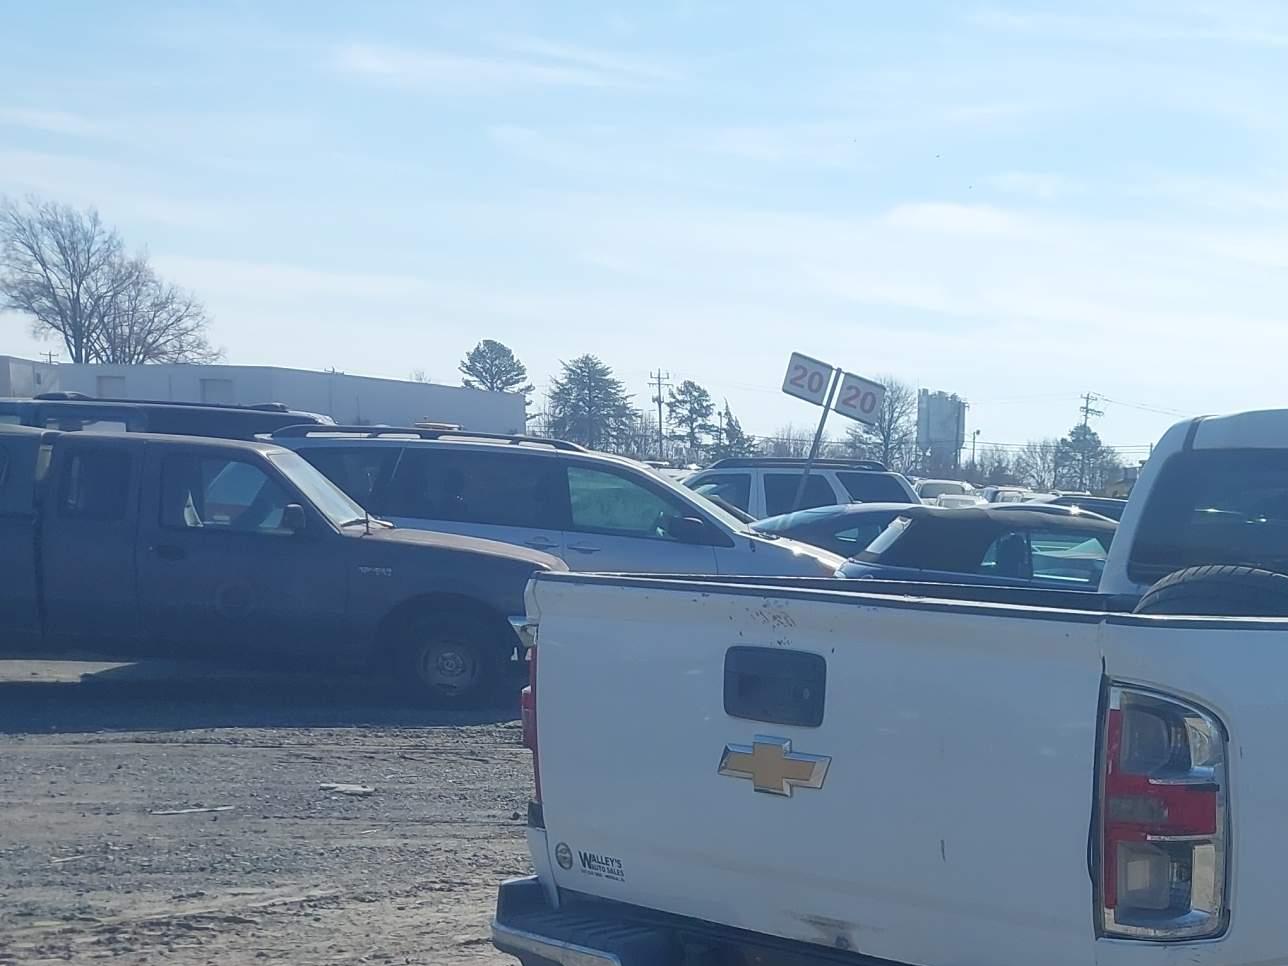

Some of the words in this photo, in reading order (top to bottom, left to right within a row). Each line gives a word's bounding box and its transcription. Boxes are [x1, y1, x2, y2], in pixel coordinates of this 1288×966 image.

[789, 365, 824, 393] 20
[842, 385, 877, 414] 20
[591, 864, 606, 873] AUTO
[607, 866, 625, 877] SALES
